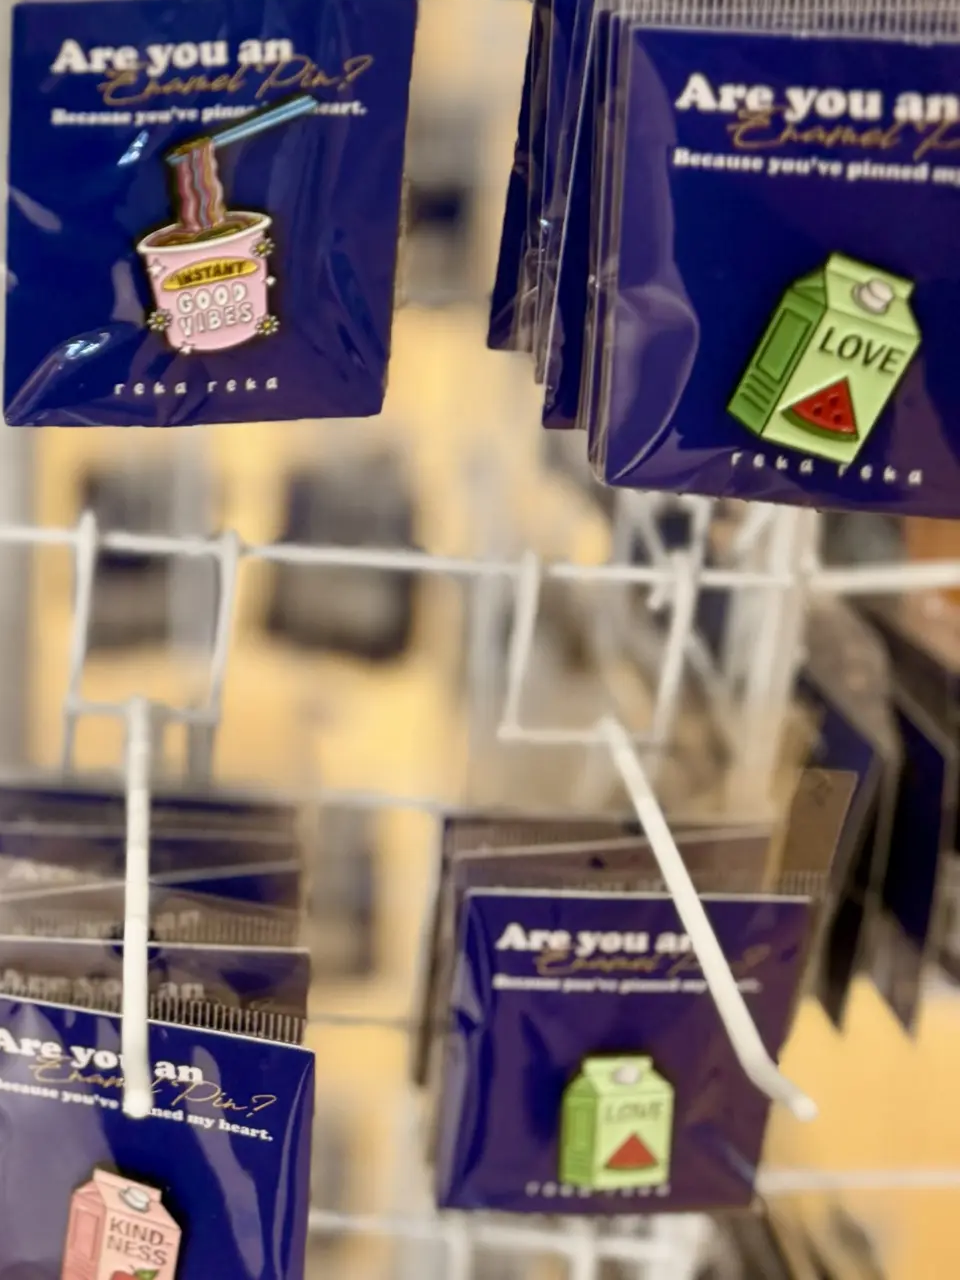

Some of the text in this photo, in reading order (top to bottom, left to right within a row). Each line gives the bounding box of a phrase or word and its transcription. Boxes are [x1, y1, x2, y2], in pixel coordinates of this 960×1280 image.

[51, 38, 291, 77] Are you an
[255, 54, 374, 99] Pin?
[674, 72, 959, 122] Are you an
[673, 147, 763, 170] Because
[846, 161, 929, 182] pinned
[177, 261, 244, 285] INSTANT
[177, 281, 247, 315] GOOD
[179, 302, 253, 337] VIBES
[819, 326, 907, 375] LOVE
[114, 377, 278, 396] reka reka
[495, 923, 571, 950] Are
[574, 930, 649, 957] you
[154, 1060, 203, 1082] an
[171, 1079, 278, 1119] Pin?
[187, 1113, 215, 1129] my
[219, 1119, 273, 1141] heart.
[110, 1217, 173, 1246] KIND-
[107, 1235, 167, 1265] NESS
